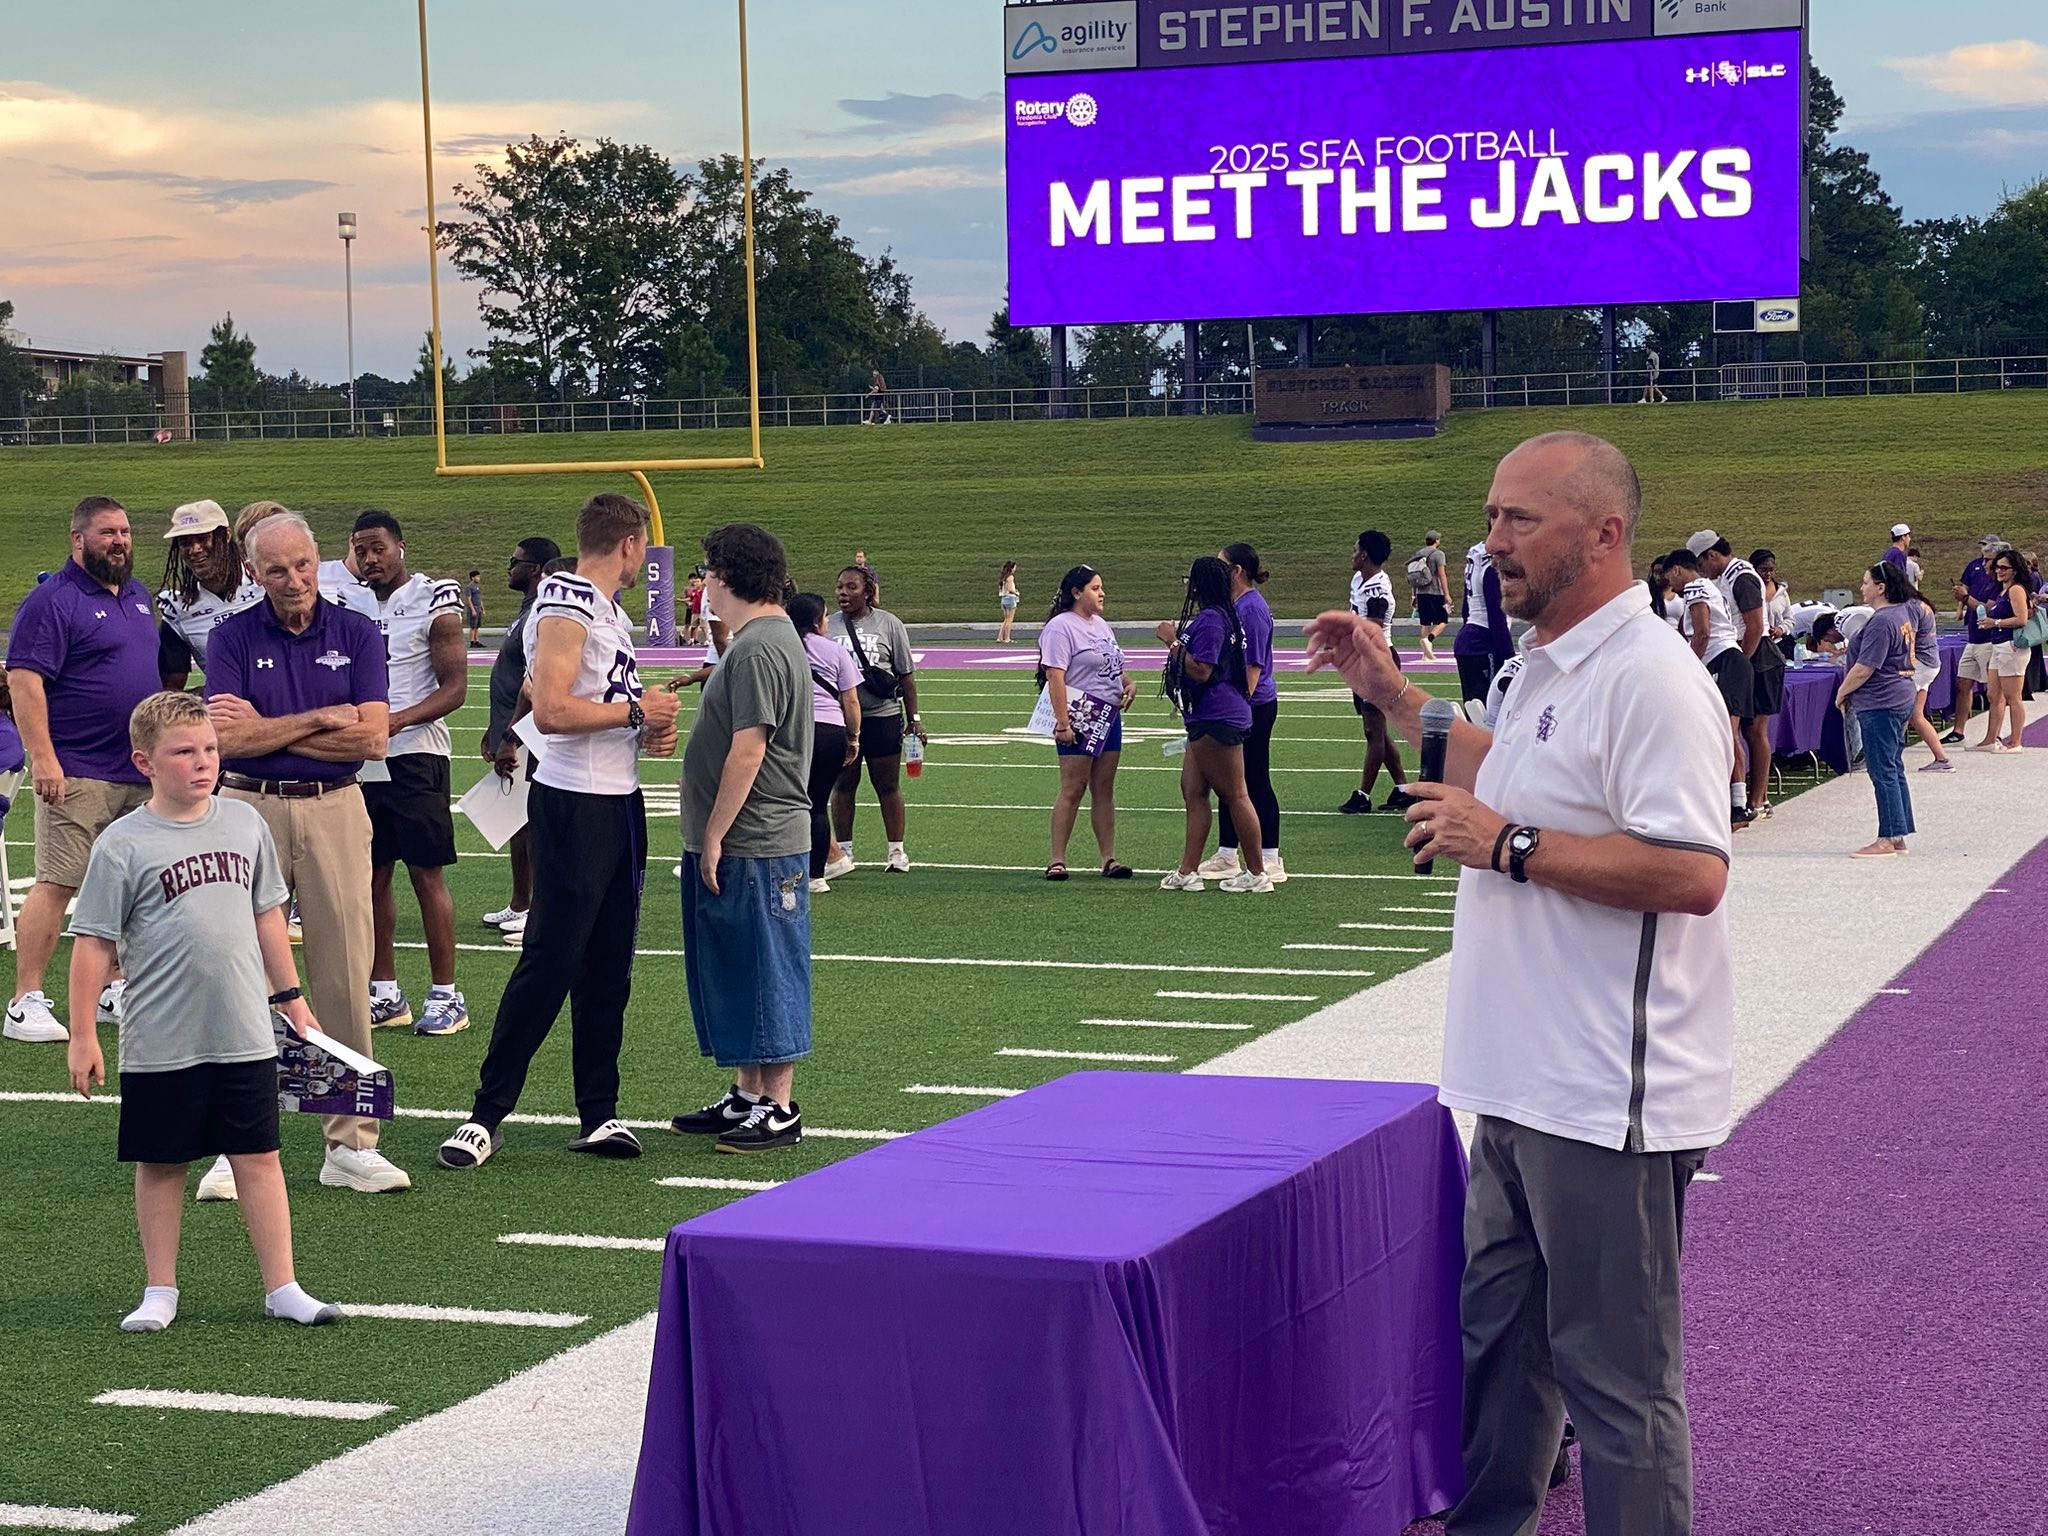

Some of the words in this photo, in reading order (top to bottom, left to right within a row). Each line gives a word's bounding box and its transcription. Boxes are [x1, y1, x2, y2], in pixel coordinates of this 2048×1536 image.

[1695, 1, 1727, 14] Bank
[1061, 20, 1128, 46] agility
[1159, 0, 1380, 50] STEPHEN
[1402, 0, 1433, 37] F.
[1449, 0, 1631, 34] AUSTIN
[1062, 46, 1095, 54] insurance
[1096, 44, 1126, 52] services
[1746, 64, 1785, 78] SLC
[1015, 100, 1065, 117] Rotary
[1209, 143, 1290, 174] 2025
[1299, 139, 1366, 170] SFA
[1376, 128, 1569, 166] FOOTBALL
[1049, 172, 1267, 247] MEET
[1285, 163, 1448, 237] THE
[1470, 147, 1753, 229] JACKS
[1764, 310, 1790, 321] Ford
[1320, 399, 1370, 413] TRACK
[214, 611, 234, 627] SF
[1085, 703, 1112, 754] SCHEDULE
[158, 851, 251, 905] REGENTS
[453, 1128, 487, 1153] NIKE
